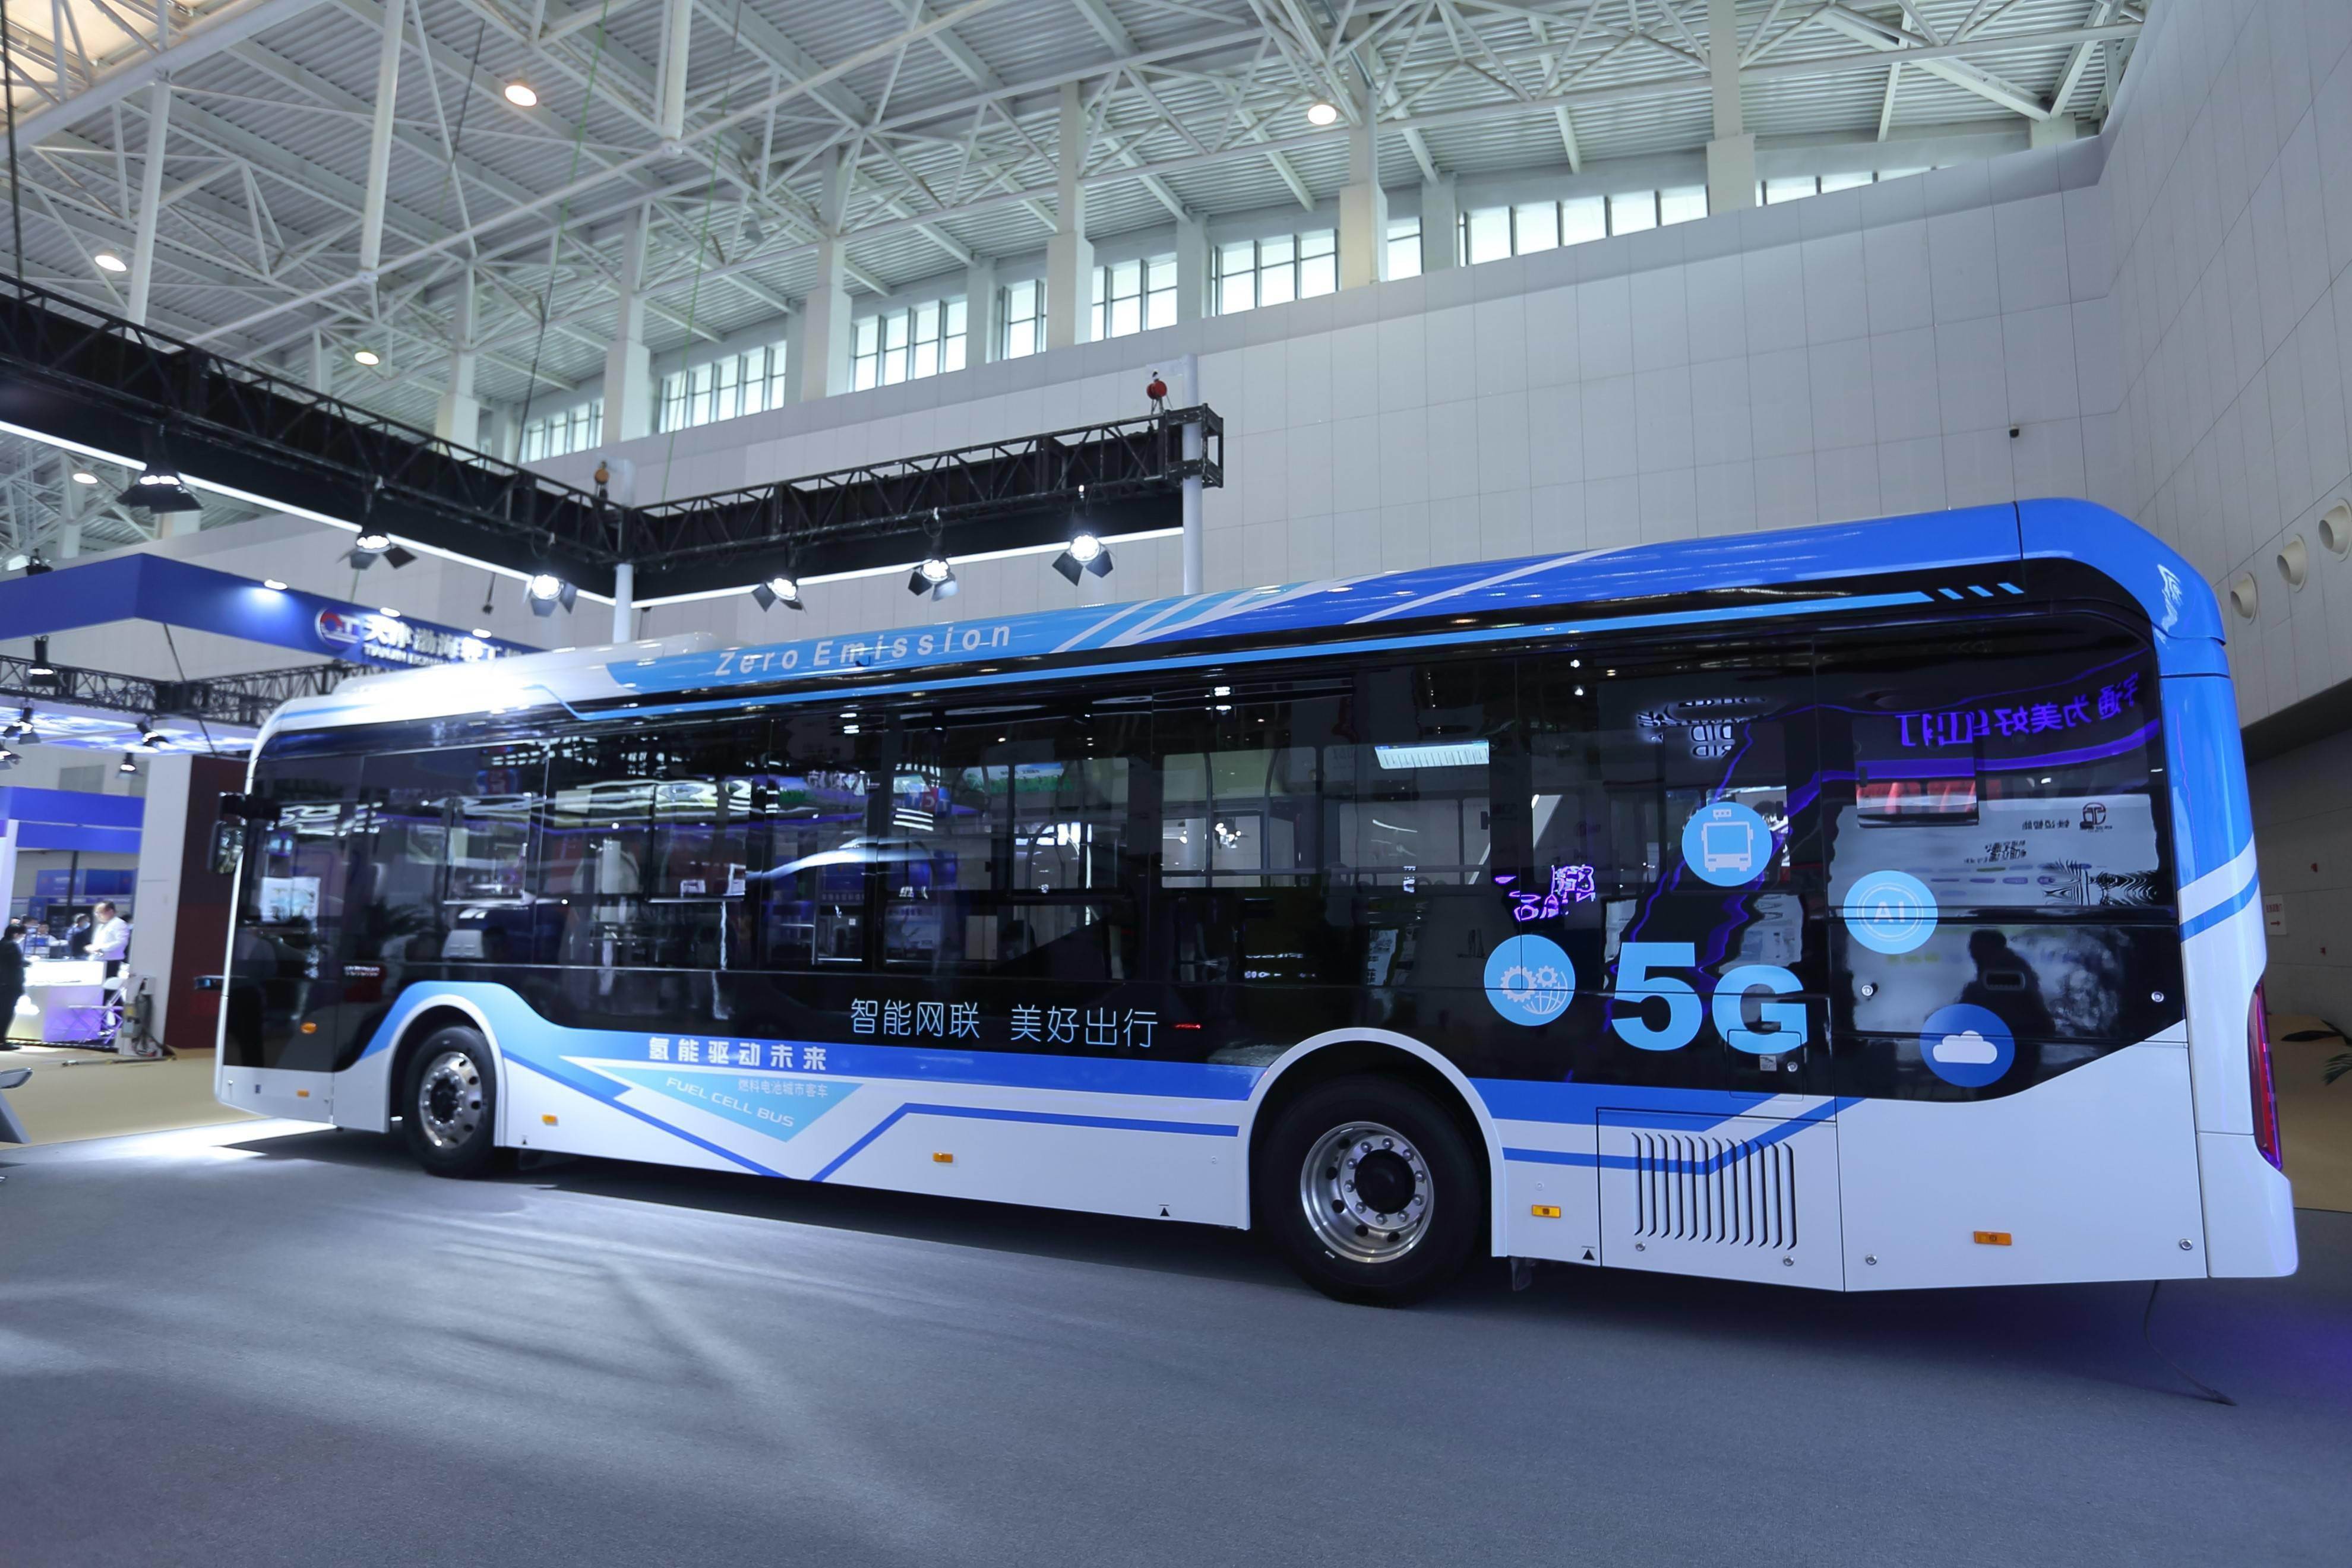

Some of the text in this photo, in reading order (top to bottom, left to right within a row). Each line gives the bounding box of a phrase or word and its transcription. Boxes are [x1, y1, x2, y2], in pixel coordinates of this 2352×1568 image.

[715, 625, 1010, 677] Zero Emission
[1873, 900, 1905, 923] AI
[851, 998, 1158, 1048] 智能网联 美好出行
[1611, 943, 1807, 1054] 5G
[649, 1037, 826, 1070] 氢能驱动未来
[666, 1077, 794, 1127] FUEL CELL BUS
[738, 1078, 829, 1098] 燃料电池城市客车
